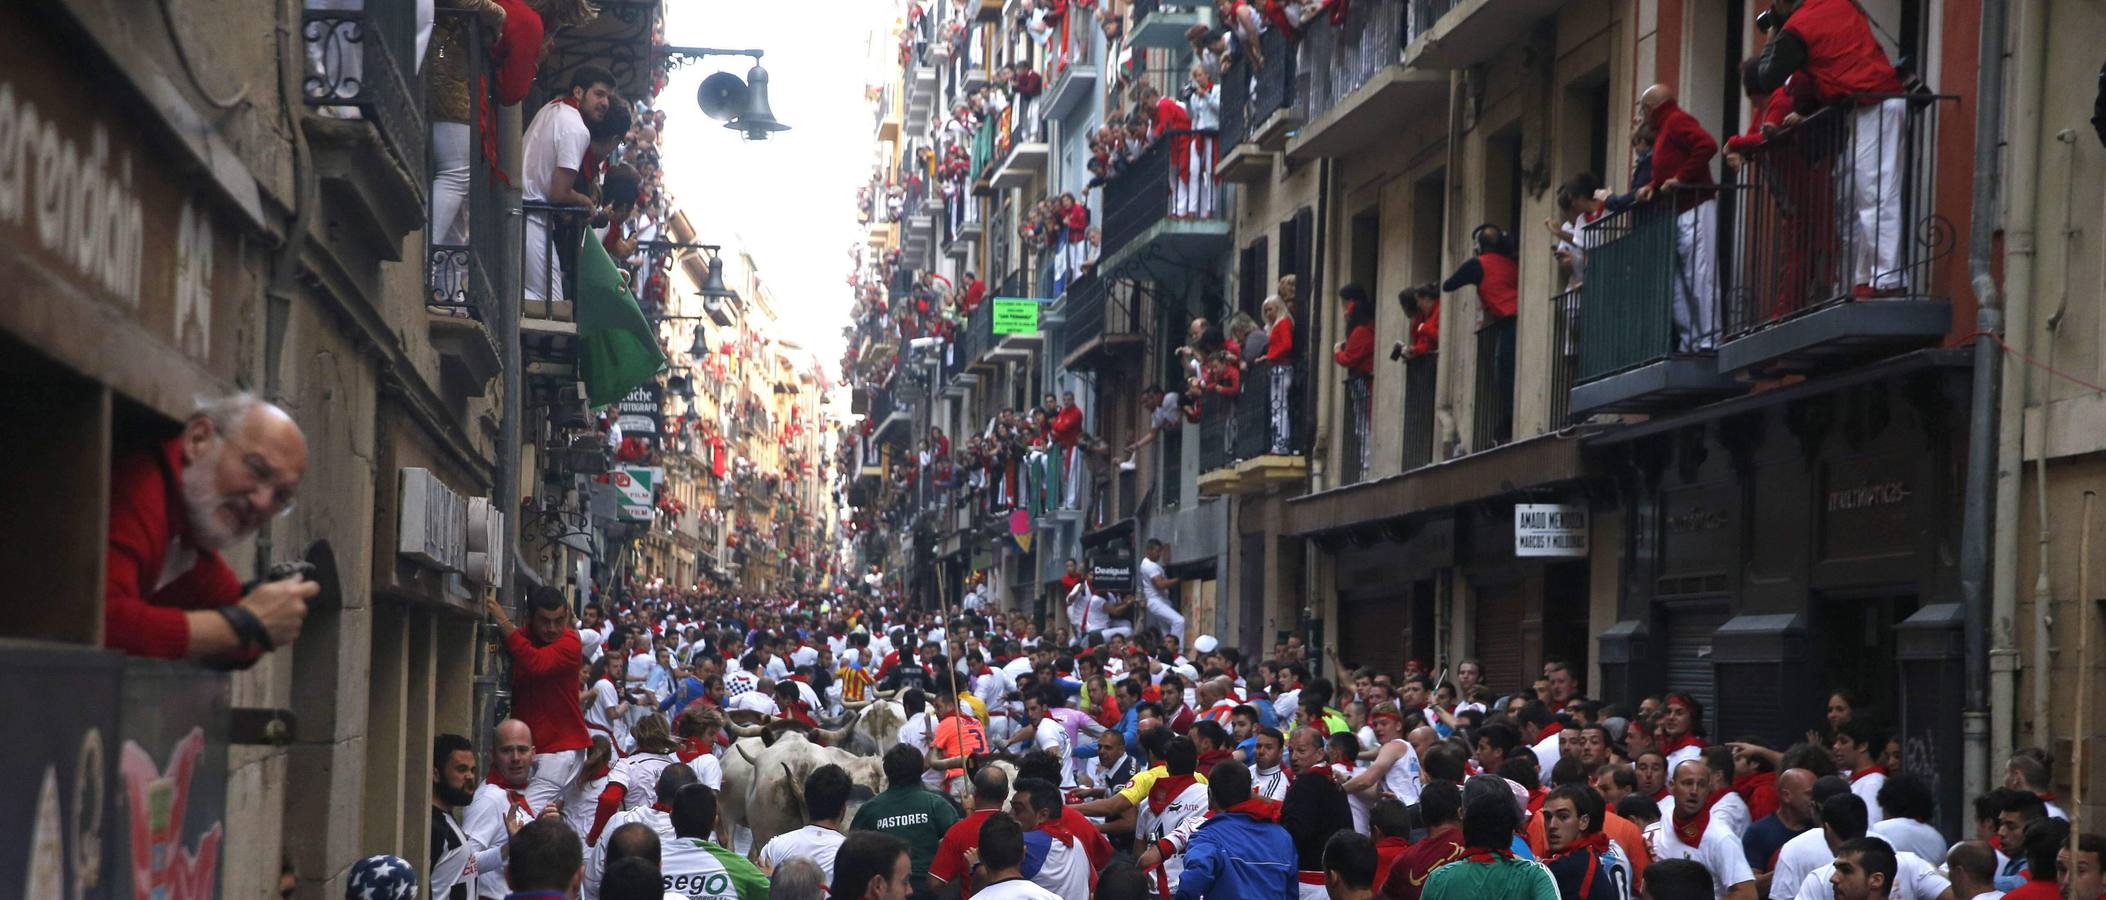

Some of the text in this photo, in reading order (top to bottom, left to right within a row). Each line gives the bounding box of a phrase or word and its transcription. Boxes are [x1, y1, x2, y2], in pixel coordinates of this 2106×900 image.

[1520, 512, 1585, 529] AMADO MENDOZA
[1520, 536, 1585, 548] MARCOS Y MOLDURAS
[877, 813, 928, 830] PASTORES
